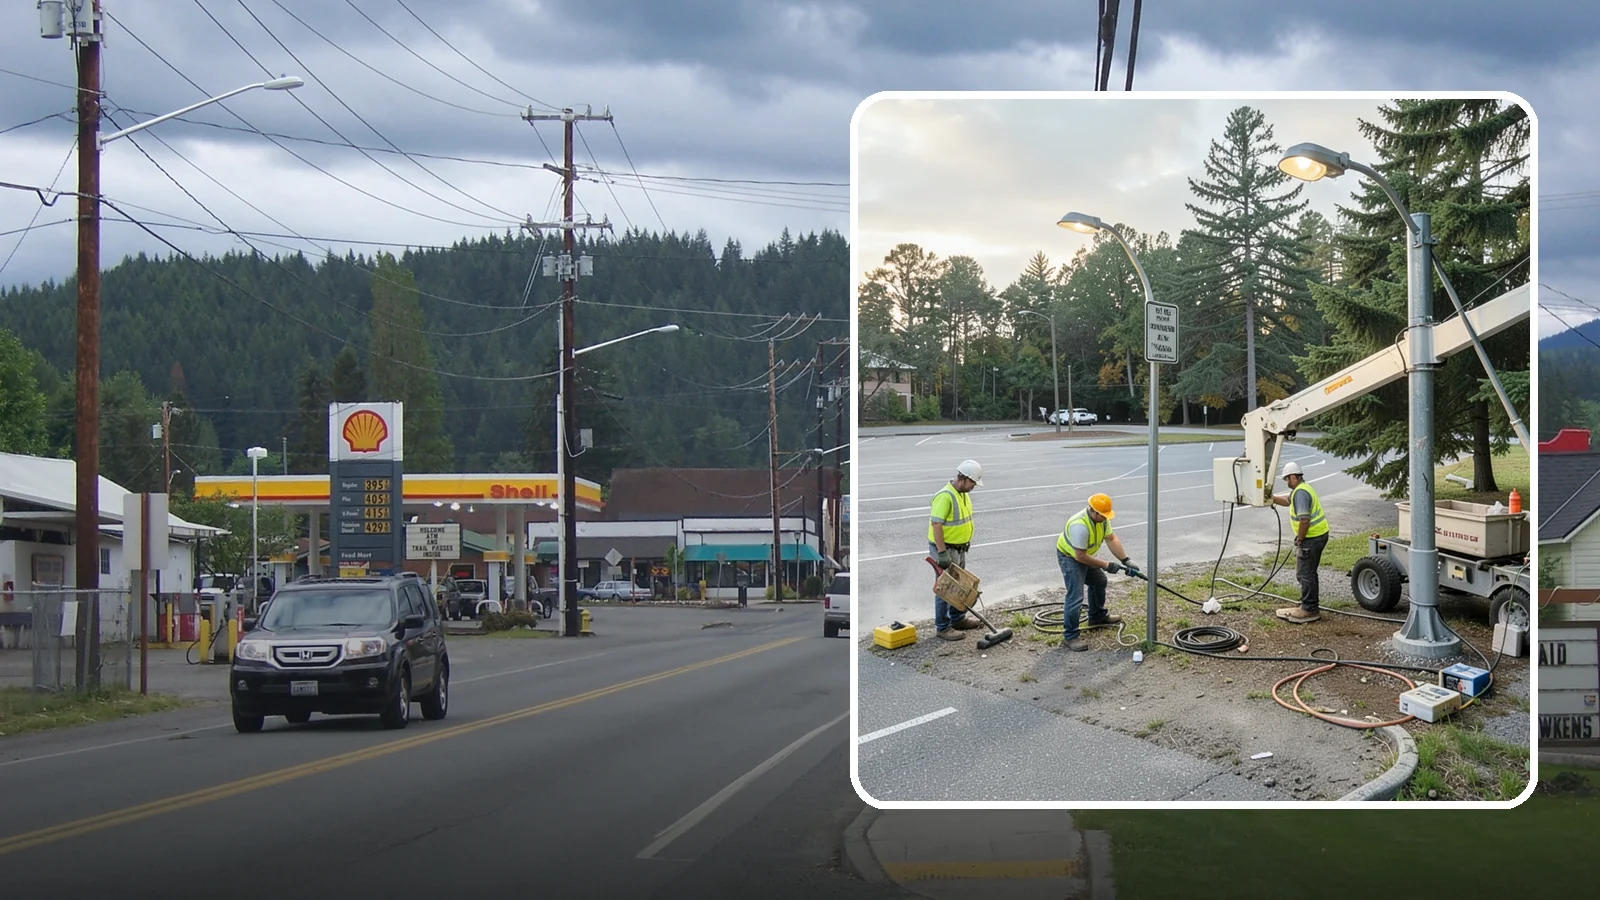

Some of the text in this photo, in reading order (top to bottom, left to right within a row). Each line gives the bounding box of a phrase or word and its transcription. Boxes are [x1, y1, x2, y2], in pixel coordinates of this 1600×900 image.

[365, 480, 383, 490] 395
[490, 484, 547, 499] Shell
[365, 494, 383, 504] 405
[365, 508, 383, 518] 415
[365, 522, 383, 532] 429
